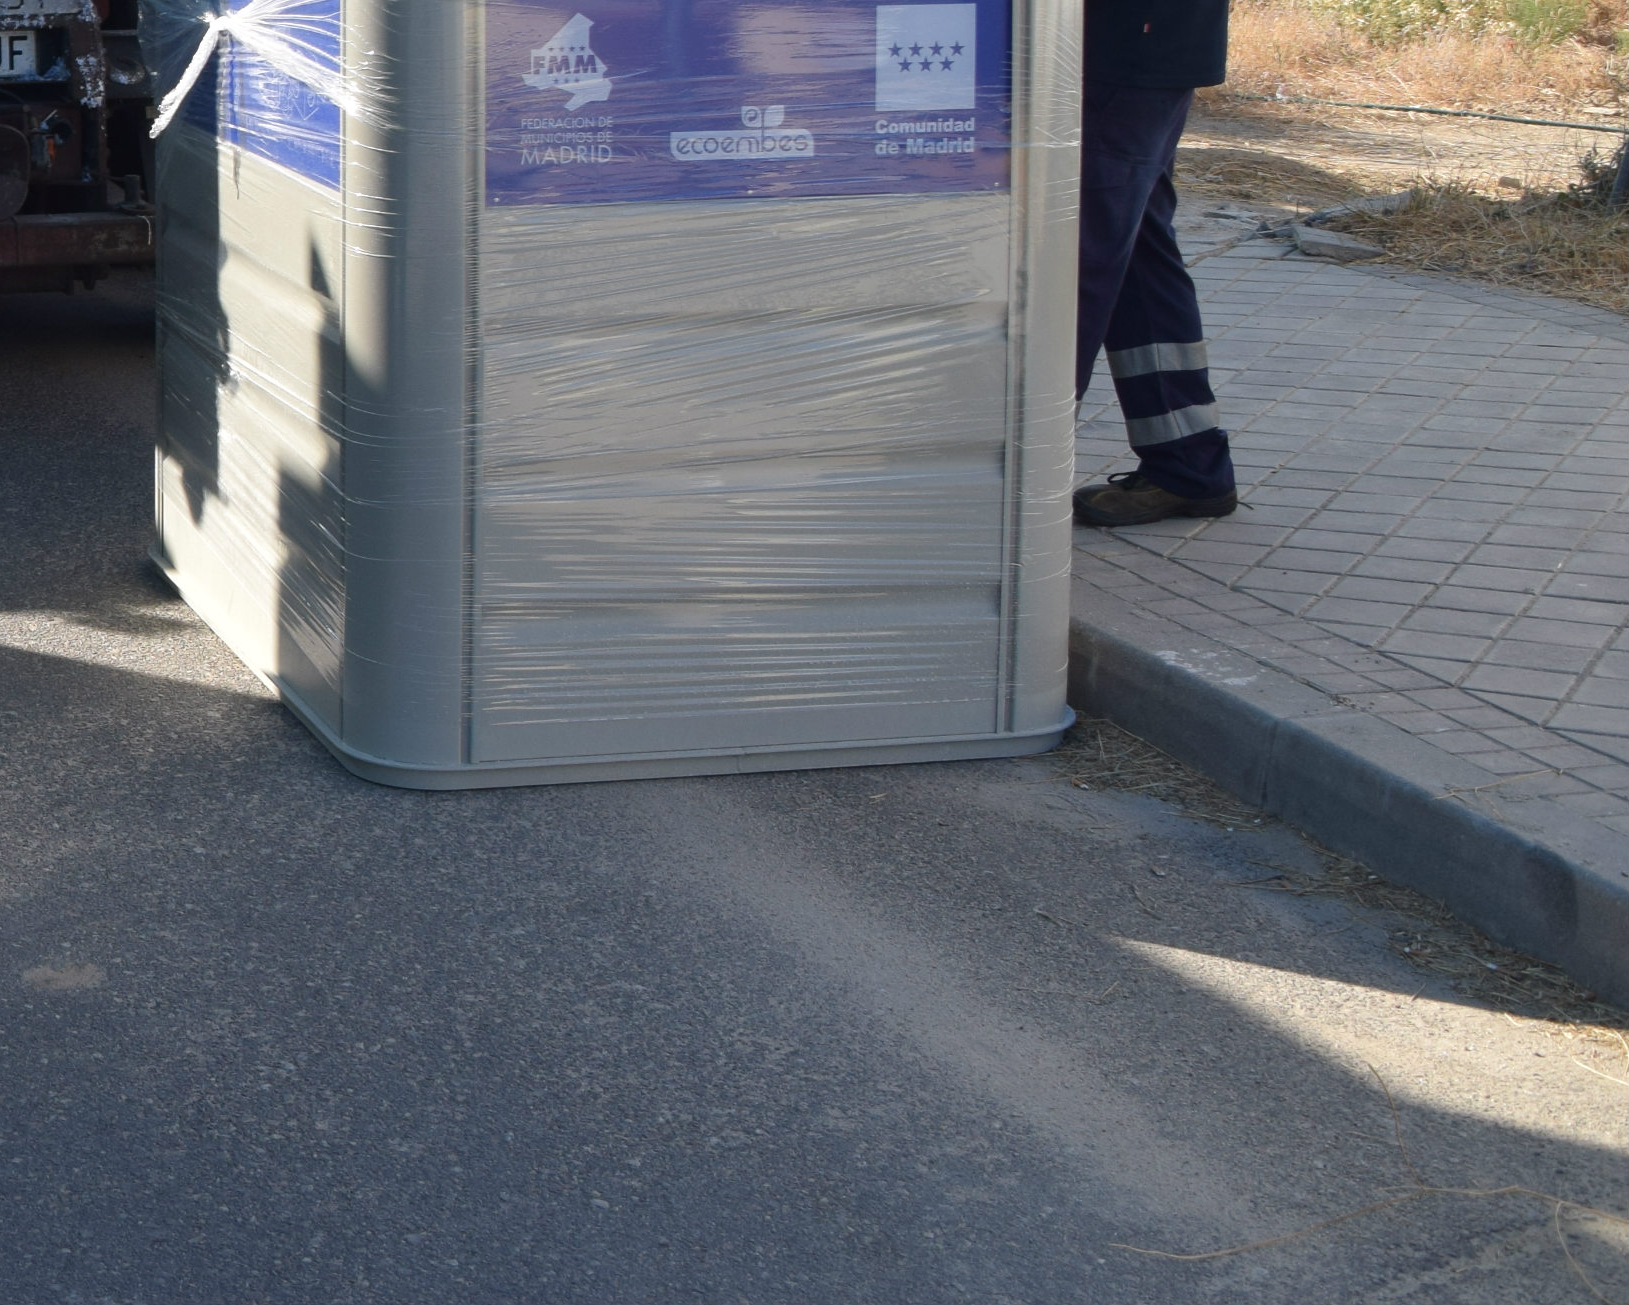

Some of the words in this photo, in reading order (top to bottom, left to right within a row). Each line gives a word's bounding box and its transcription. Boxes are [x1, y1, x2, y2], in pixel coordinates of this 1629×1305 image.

[532, 54, 597, 75] FMM
[598, 116, 614, 127] DE
[875, 117, 976, 134] Comunidad
[520, 132, 593, 145] MUNICIPIOS
[597, 131, 614, 143] DE
[676, 132, 808, 155] ecoembes
[875, 139, 899, 155] de
[906, 136, 975, 154] Madrid
[521, 144, 612, 165] MADRID
